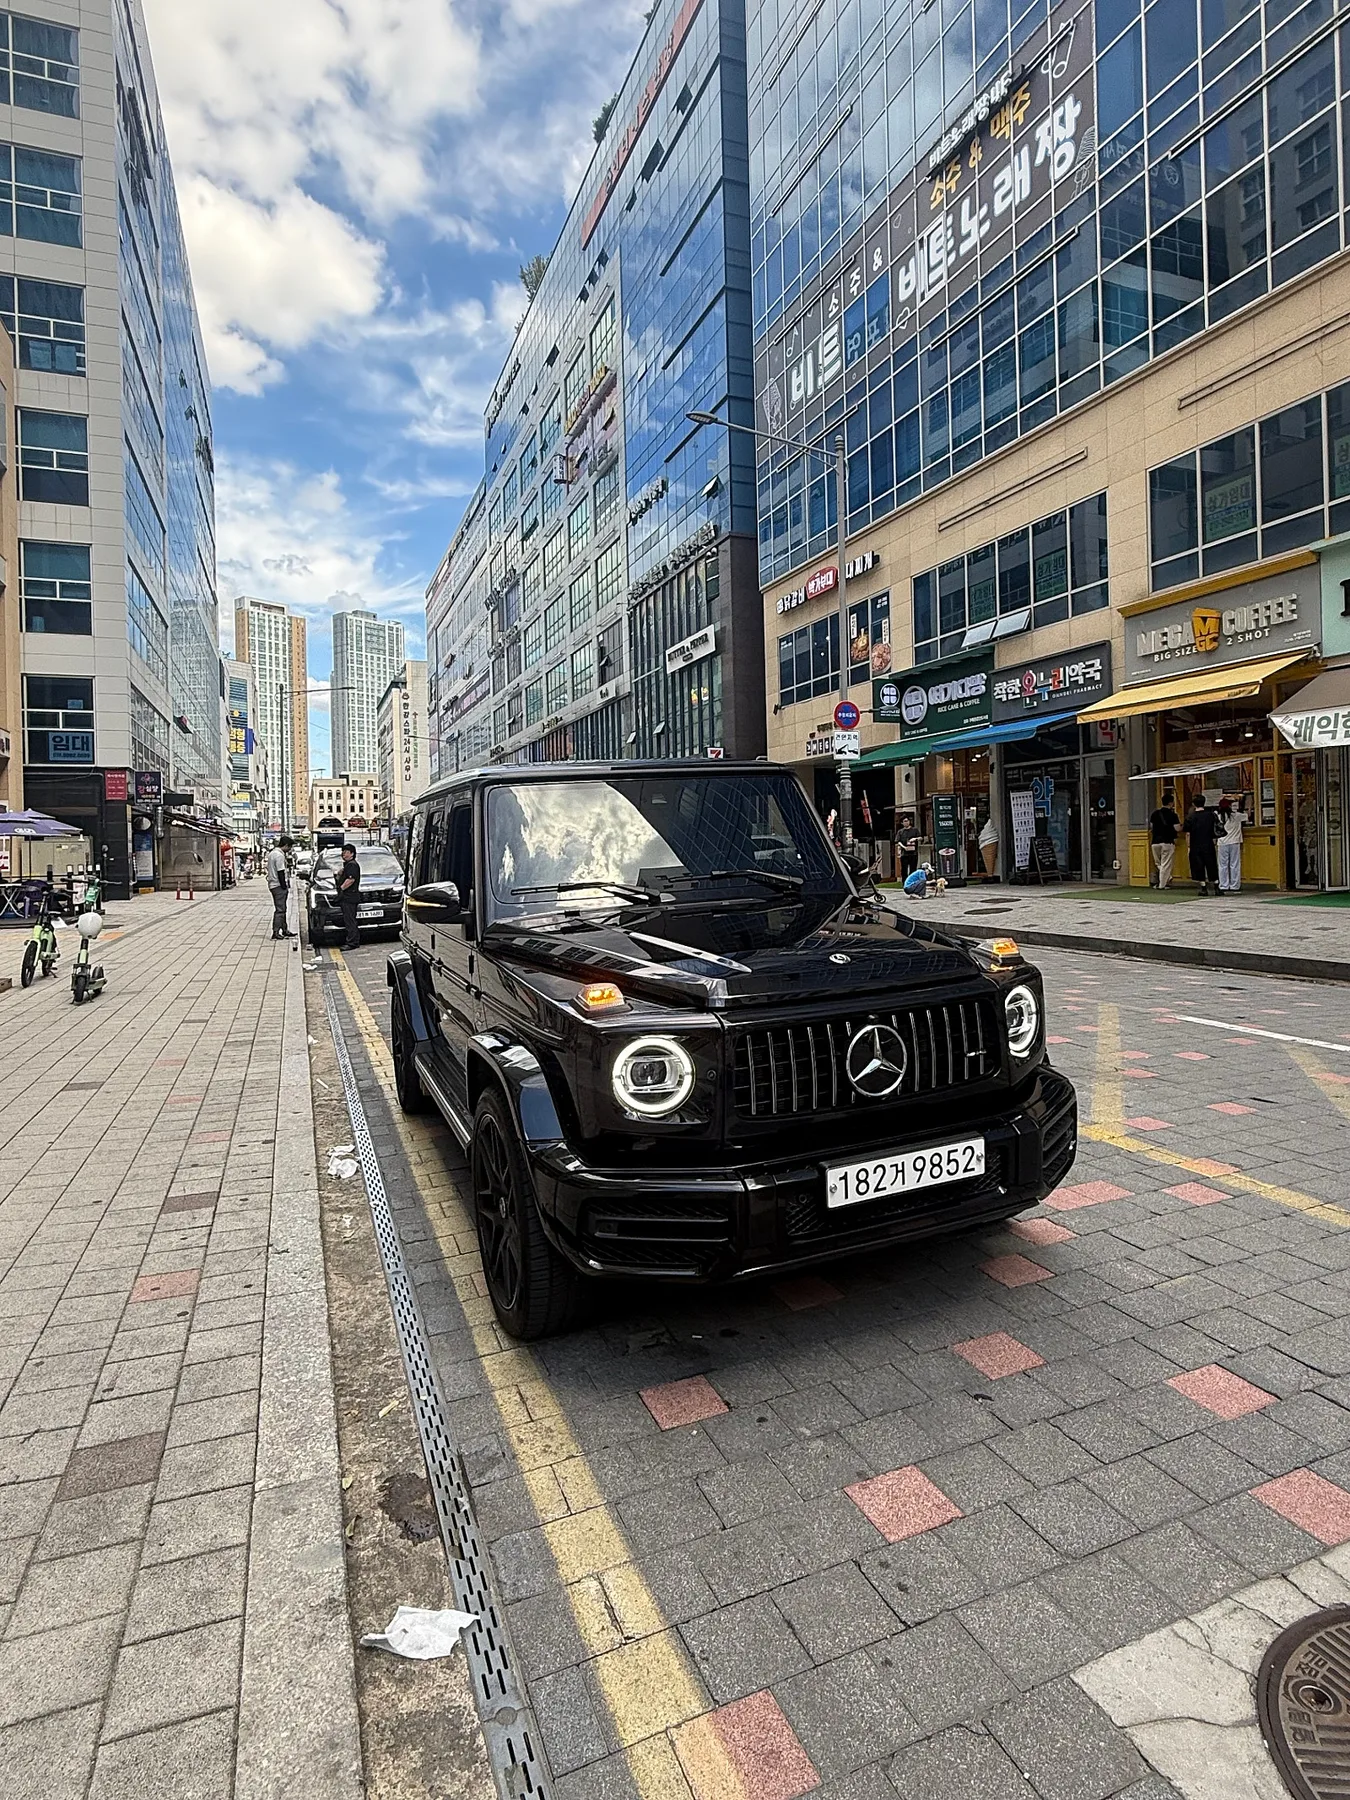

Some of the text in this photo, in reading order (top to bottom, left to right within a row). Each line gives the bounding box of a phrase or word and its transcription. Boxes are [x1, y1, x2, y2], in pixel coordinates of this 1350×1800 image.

[930, 80, 1031, 210] 소주 & 맥주
[828, 247, 883, 318] 소주 &
[790, 321, 843, 403] 비트
[840, 551, 874, 580] 대찌개
[1136, 593, 1298, 657] MEGA COFFEE
[1153, 652, 1171, 662] BIG
[1175, 645, 1198, 657] SIZE
[1226, 637, 1234, 646] 2
[1237, 628, 1271, 644] SHOT
[1073, 683, 1103, 695] PHARMACY
[52, 735, 90, 751] 임대
[835, 733, 858, 741] 견인지역
[1031, 776, 1054, 817] 약
[839, 1145, 976, 1200] 182거 9852
